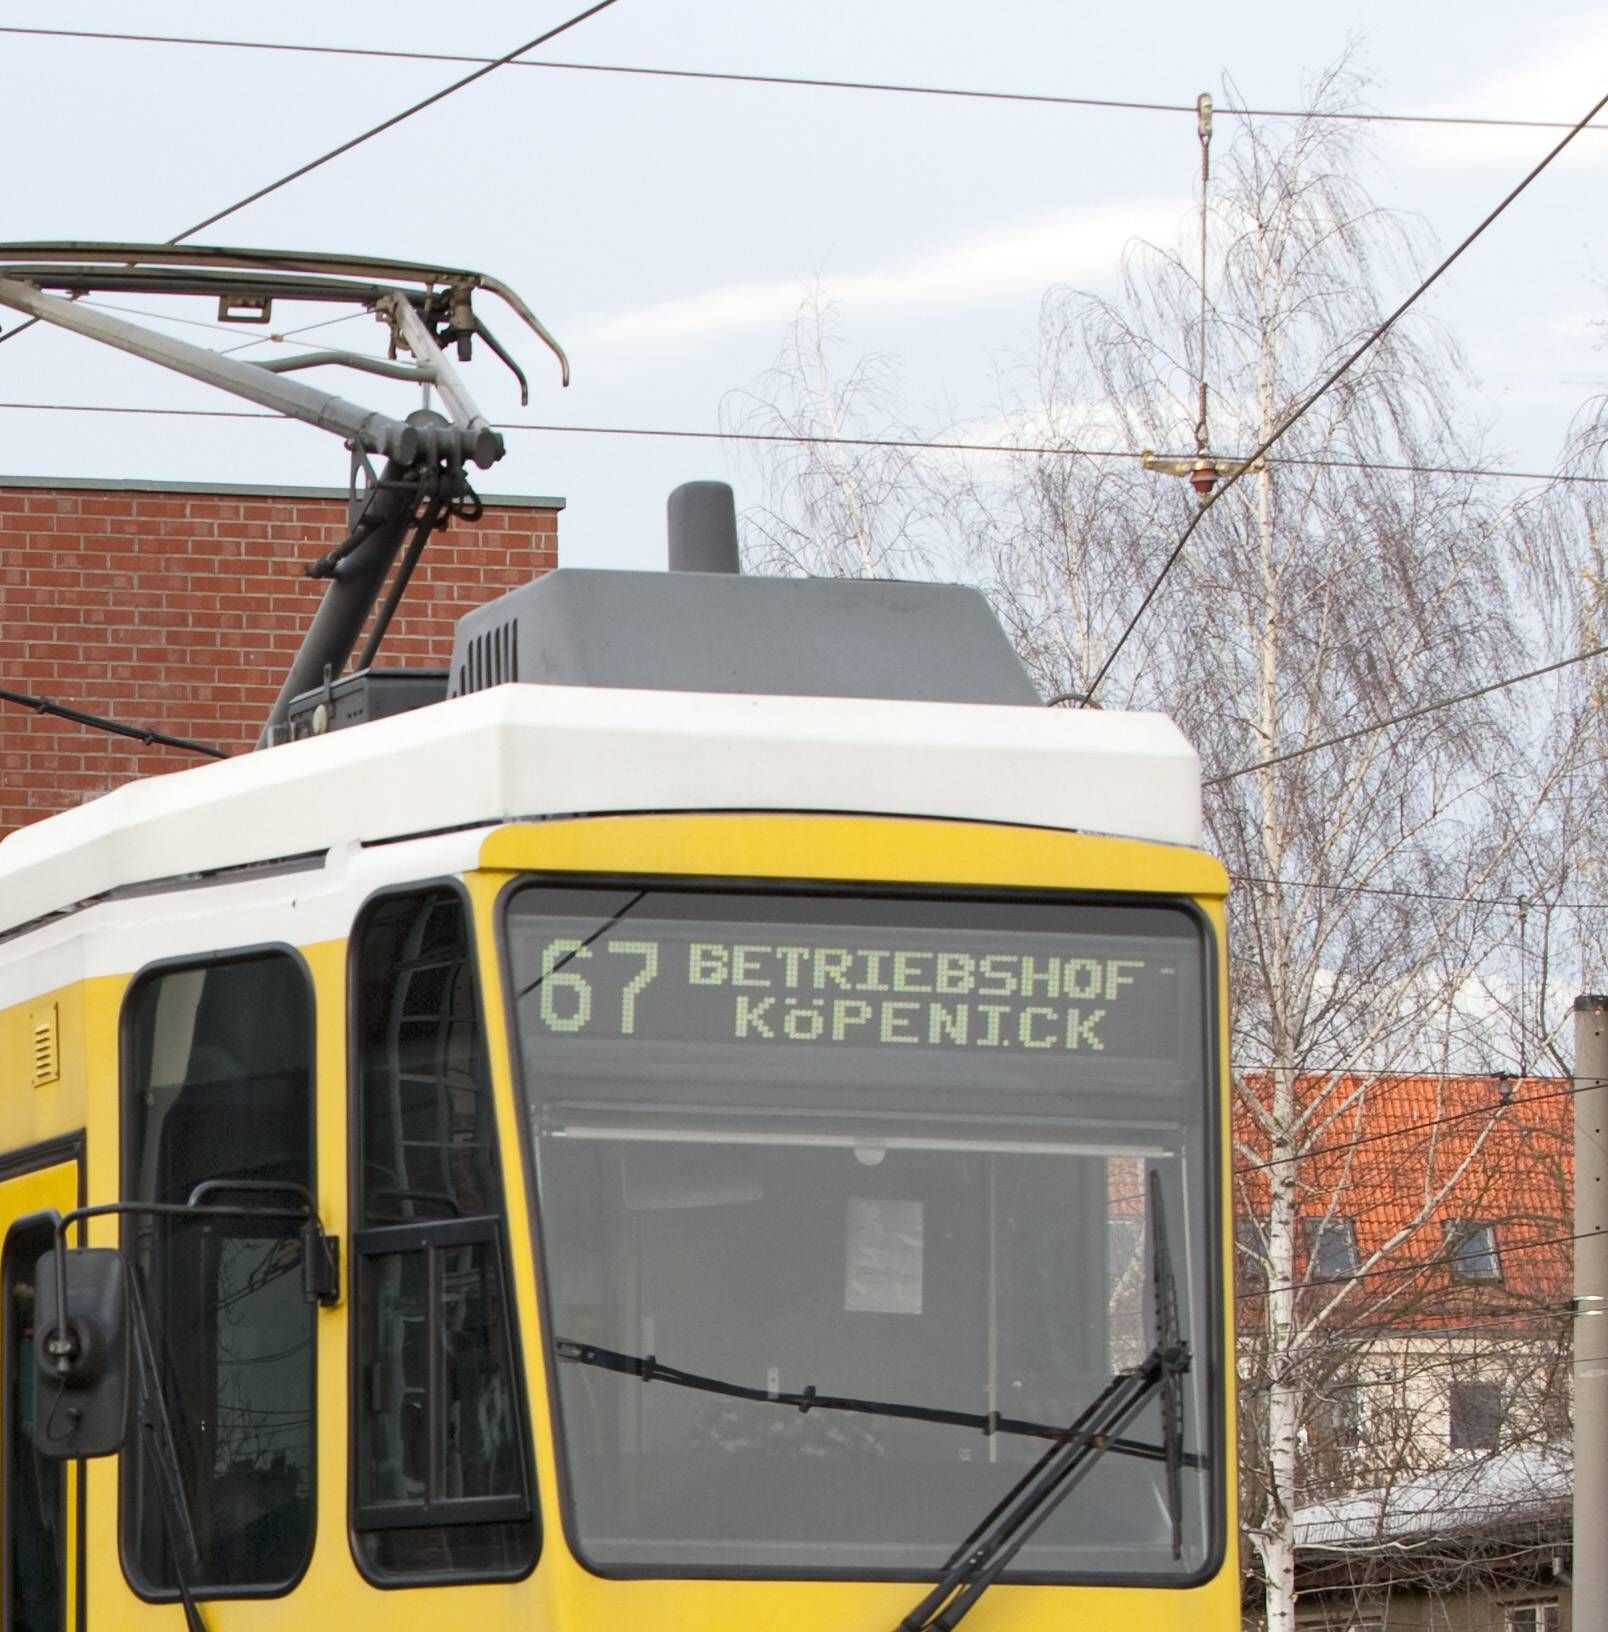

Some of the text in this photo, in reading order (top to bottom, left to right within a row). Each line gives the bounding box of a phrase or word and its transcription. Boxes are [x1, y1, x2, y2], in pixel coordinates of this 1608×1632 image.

[540, 939, 1146, 1034] 67 BETRIEBSHOF
[735, 995, 1106, 1051] KÖPENICK
